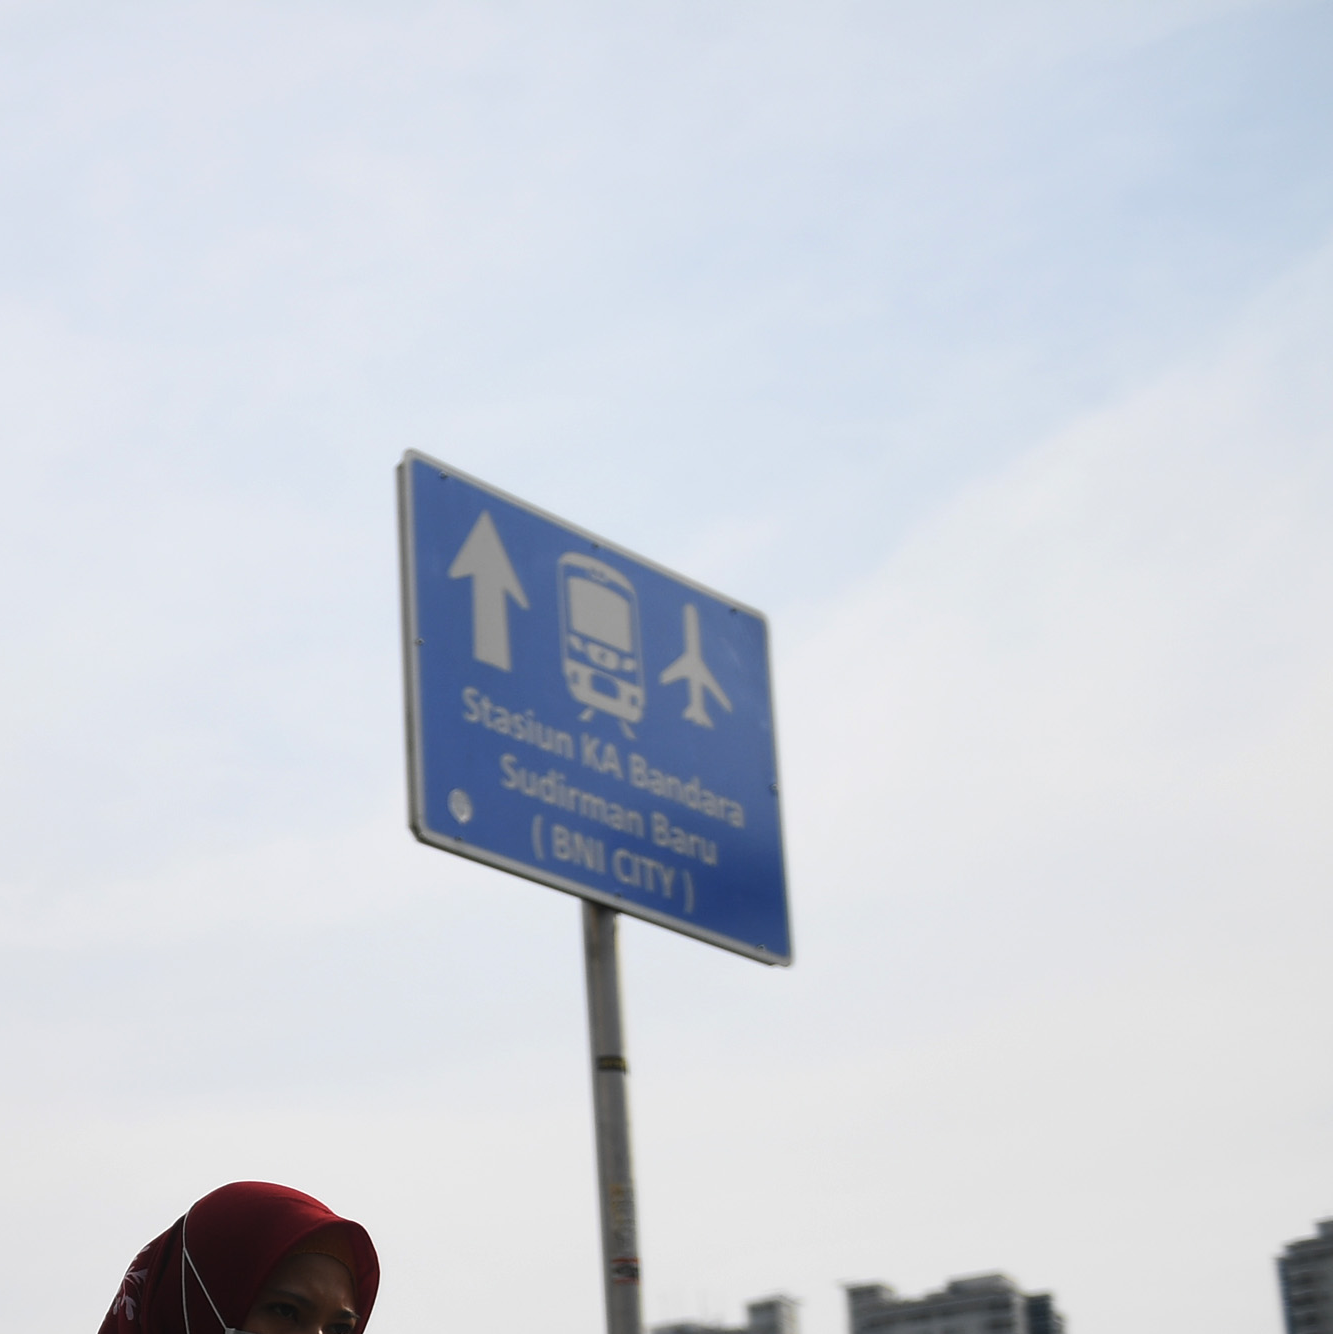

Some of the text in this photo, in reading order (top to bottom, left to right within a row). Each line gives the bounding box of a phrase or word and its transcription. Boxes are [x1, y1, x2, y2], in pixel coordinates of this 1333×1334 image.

[462, 686, 746, 829] Stasiun KA Bandara
[499, 753, 719, 867] Sudirman Baru
[551, 824, 606, 874] BNI
[613, 848, 676, 898] CITY
